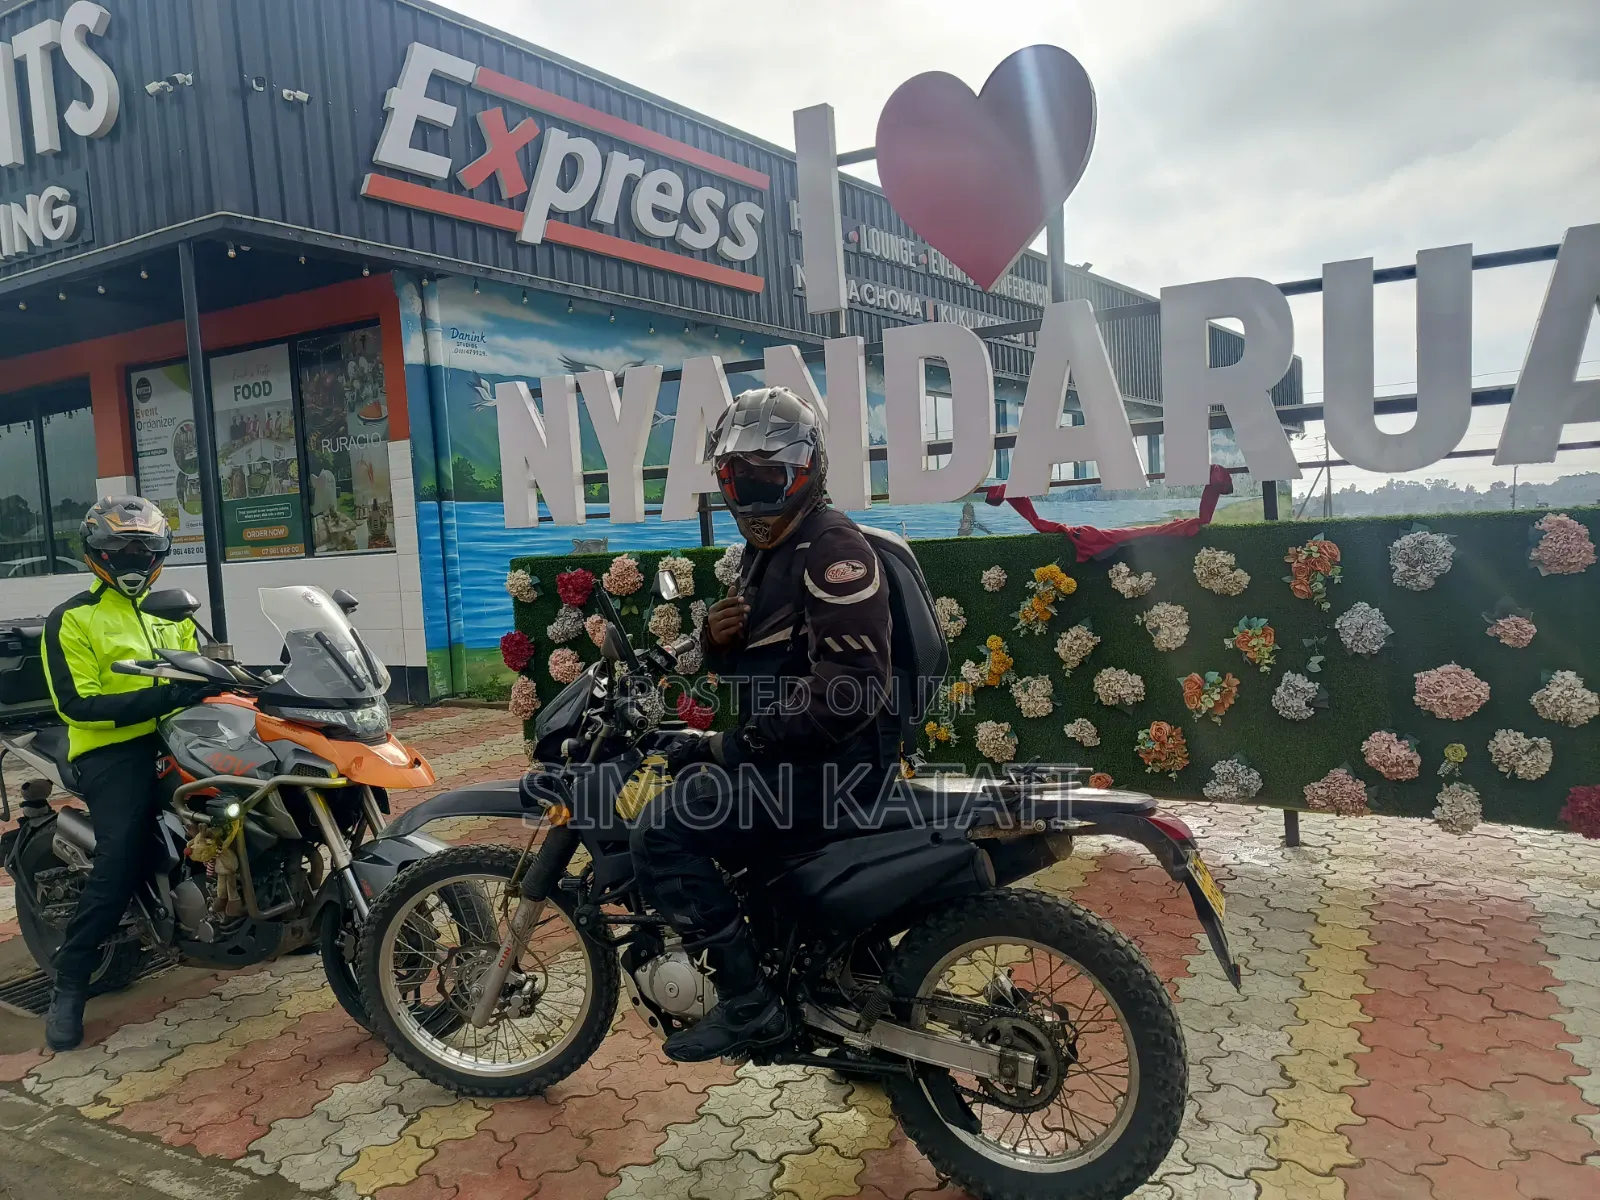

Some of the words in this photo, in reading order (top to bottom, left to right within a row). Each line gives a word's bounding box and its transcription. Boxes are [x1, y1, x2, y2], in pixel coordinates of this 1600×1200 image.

[373, 42, 764, 261] Express
[793, 102, 848, 314] I
[0, 185, 77, 260] ING
[859, 224, 916, 268] LOUNGE
[450, 327, 487, 343] Danink
[233, 380, 272, 402] FOOD
[135, 406, 158, 418] Event
[136, 416, 176, 432] Organizer
[321, 432, 381, 454] RURACIO
[246, 530, 268, 538] ORDER
[268, 528, 284, 536] NOW
